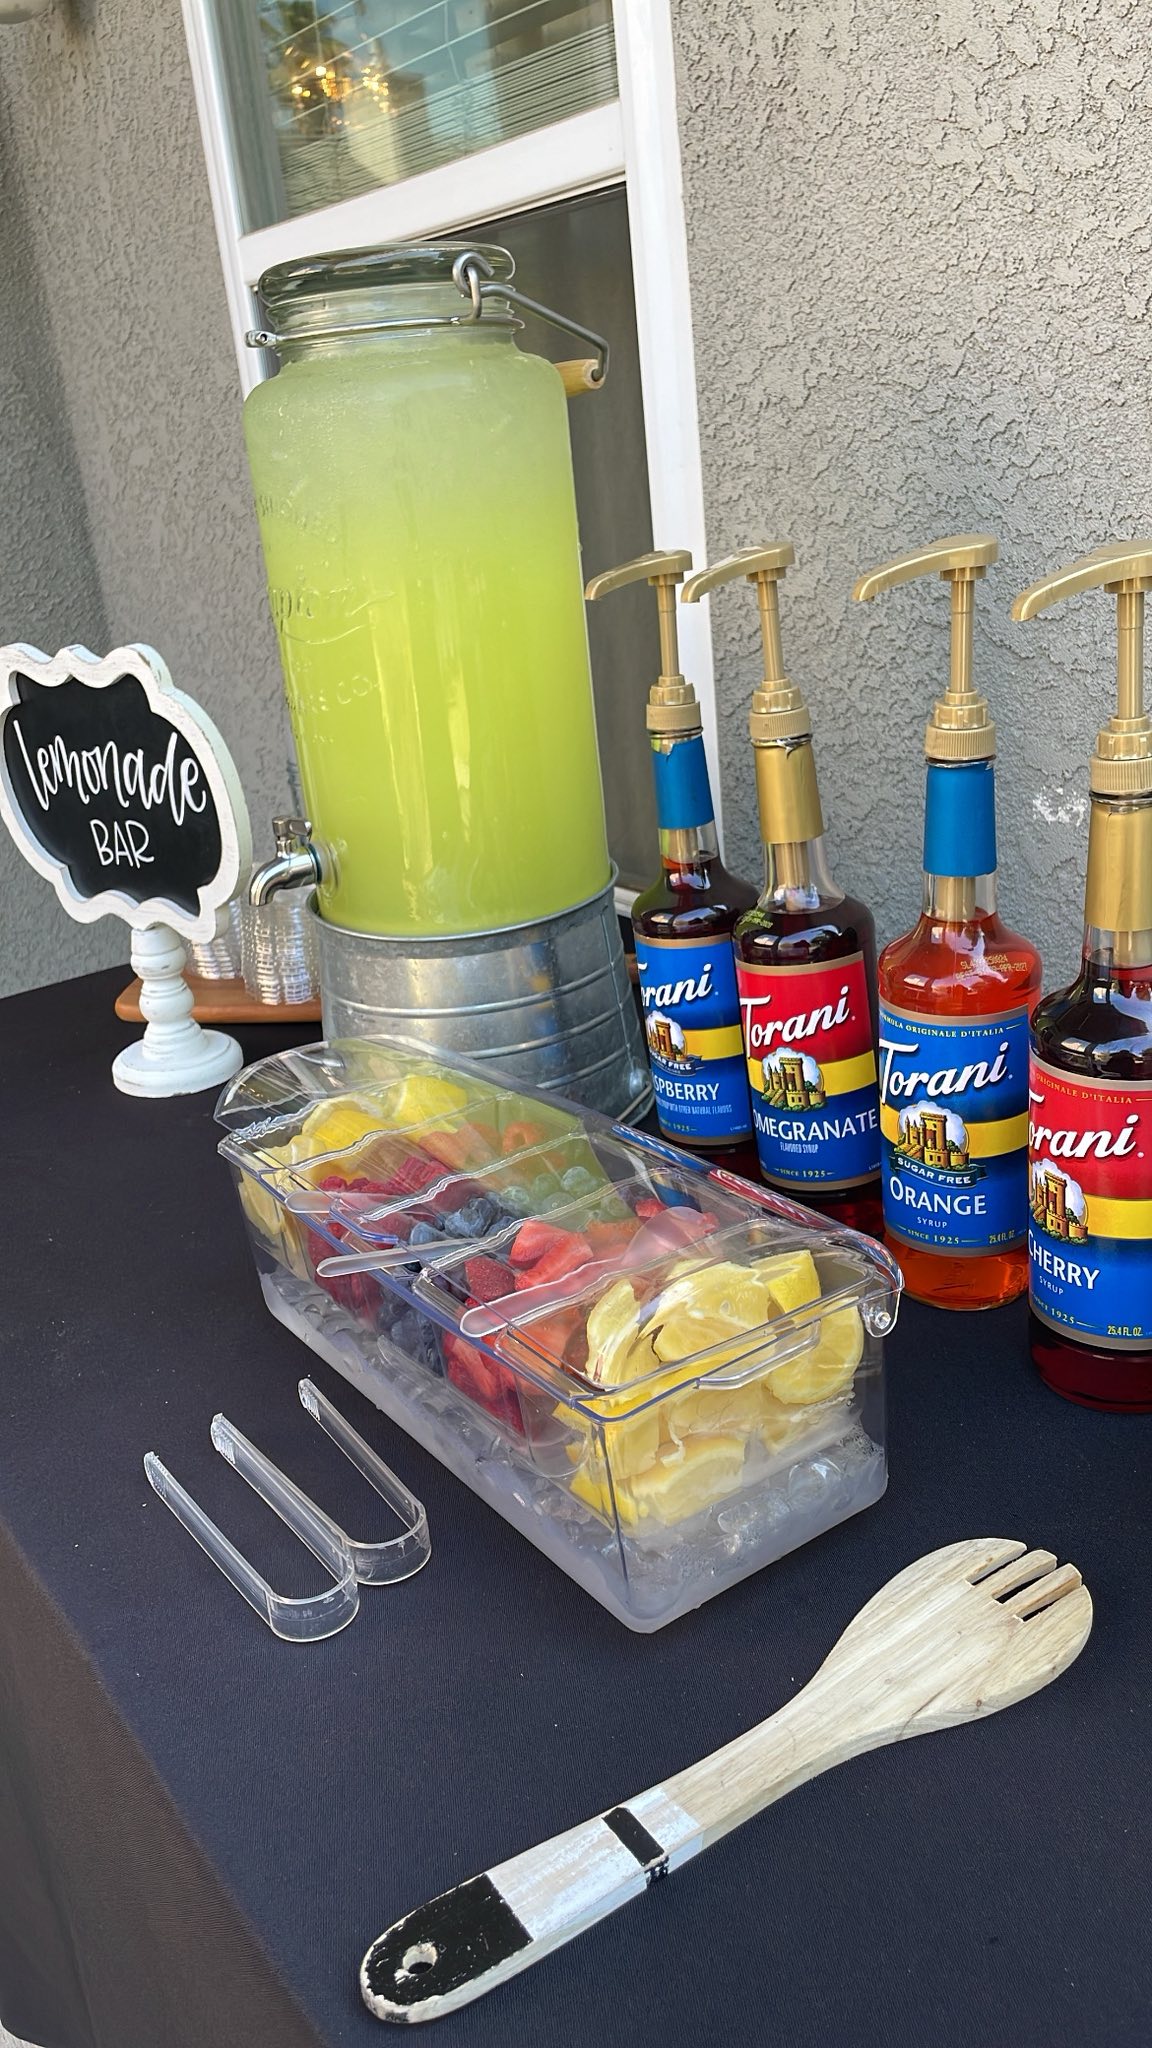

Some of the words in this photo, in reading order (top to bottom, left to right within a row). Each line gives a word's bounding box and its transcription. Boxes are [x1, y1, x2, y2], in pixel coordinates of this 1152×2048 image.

[13, 719, 207, 826] lemonade
[90, 819, 154, 868] BAR
[637, 963, 713, 1007] rani
[740, 985, 850, 1059] Torani
[905, 1024, 957, 1038] ORIGINALE
[960, 1027, 1004, 1038] D'ITALIA
[668, 1061, 692, 1071] FREE
[879, 1041, 1009, 1104] Torani
[653, 1074, 720, 1101] SPBERRY
[1036, 1071, 1078, 1097] ORIGINALE
[1081, 1091, 1133, 1104] D'ITALIA
[753, 1108, 878, 1141] OMEGRANATE
[802, 1170, 826, 1178] 1925
[897, 1157, 935, 1179] SUGAR
[937, 1174, 972, 1184] FREE
[889, 1176, 988, 1216] ORANGE
[907, 1228, 929, 1240] SINCE
[933, 1234, 959, 1244] 1925
[916, 1216, 948, 1229] SYRUP
[1028, 1228, 1101, 1290] CHERRY
[1039, 1275, 1064, 1296] SYRUP
[1051, 1307, 1075, 1324] 1925
